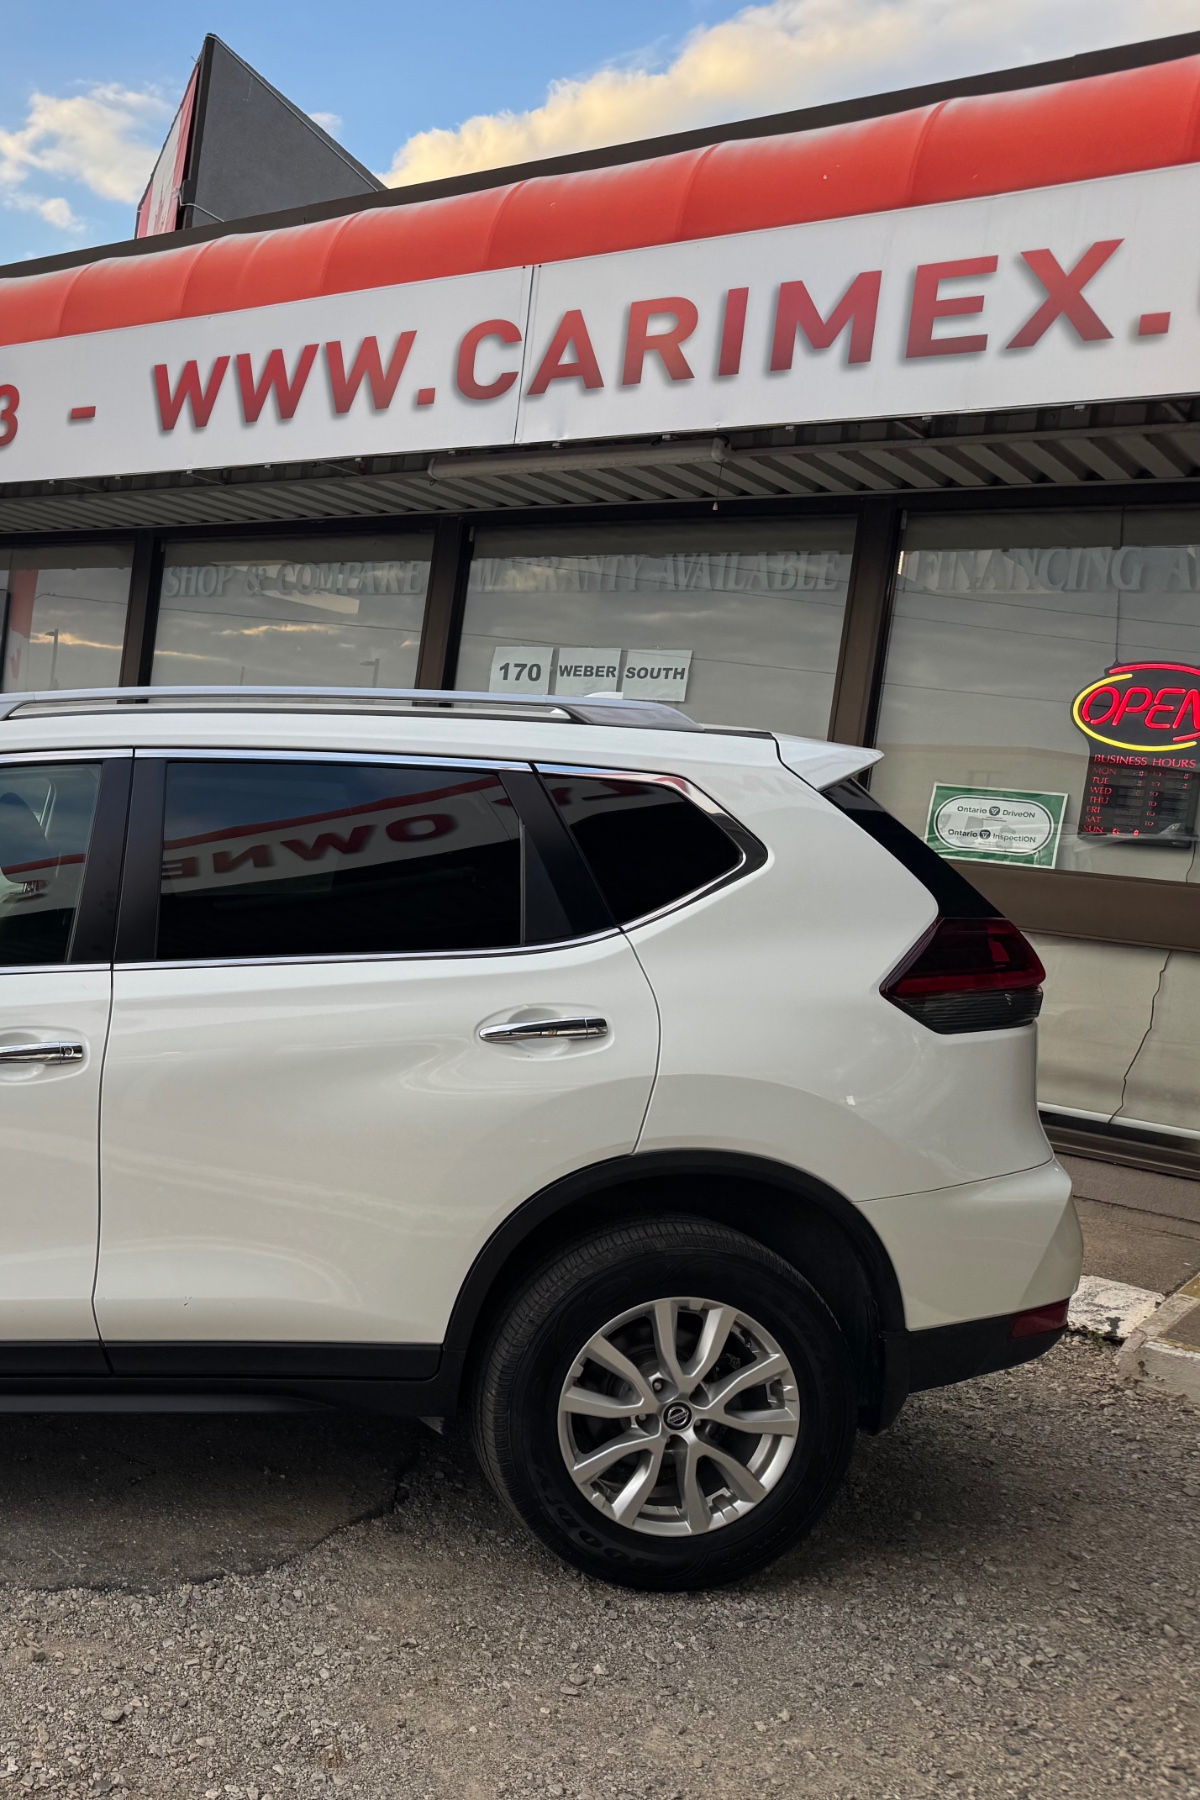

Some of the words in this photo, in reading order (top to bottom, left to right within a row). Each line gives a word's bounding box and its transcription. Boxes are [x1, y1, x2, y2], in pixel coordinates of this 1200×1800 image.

[154, 238, 1172, 432] WWW.CARIMEX.
[658, 550, 841, 592] AVAILABLE
[912, 546, 1146, 591] FINANCING
[164, 565, 235, 597] SHOP
[244, 565, 268, 595] &
[275, 561, 425, 595] COMPARE
[498, 663, 542, 682] 170
[558, 664, 617, 680] WEBER
[625, 666, 686, 681] SOUTH
[1082, 686, 1200, 730] OPEN
[1094, 754, 1148, 766] BUSINESS
[1152, 758, 1197, 768] HOURS
[1092, 767, 1117, 775] MON
[1092, 776, 1109, 784] TUE
[1090, 787, 1112, 795] WED
[1089, 796, 1109, 804] THU
[957, 805, 988, 814] Ontario
[1002, 809, 1036, 818] DriveON
[1085, 815, 1102, 823] SAT
[947, 828, 978, 838] Ontario
[992, 832, 1036, 843] InspectiON
[1084, 825, 1104, 834] SUN
